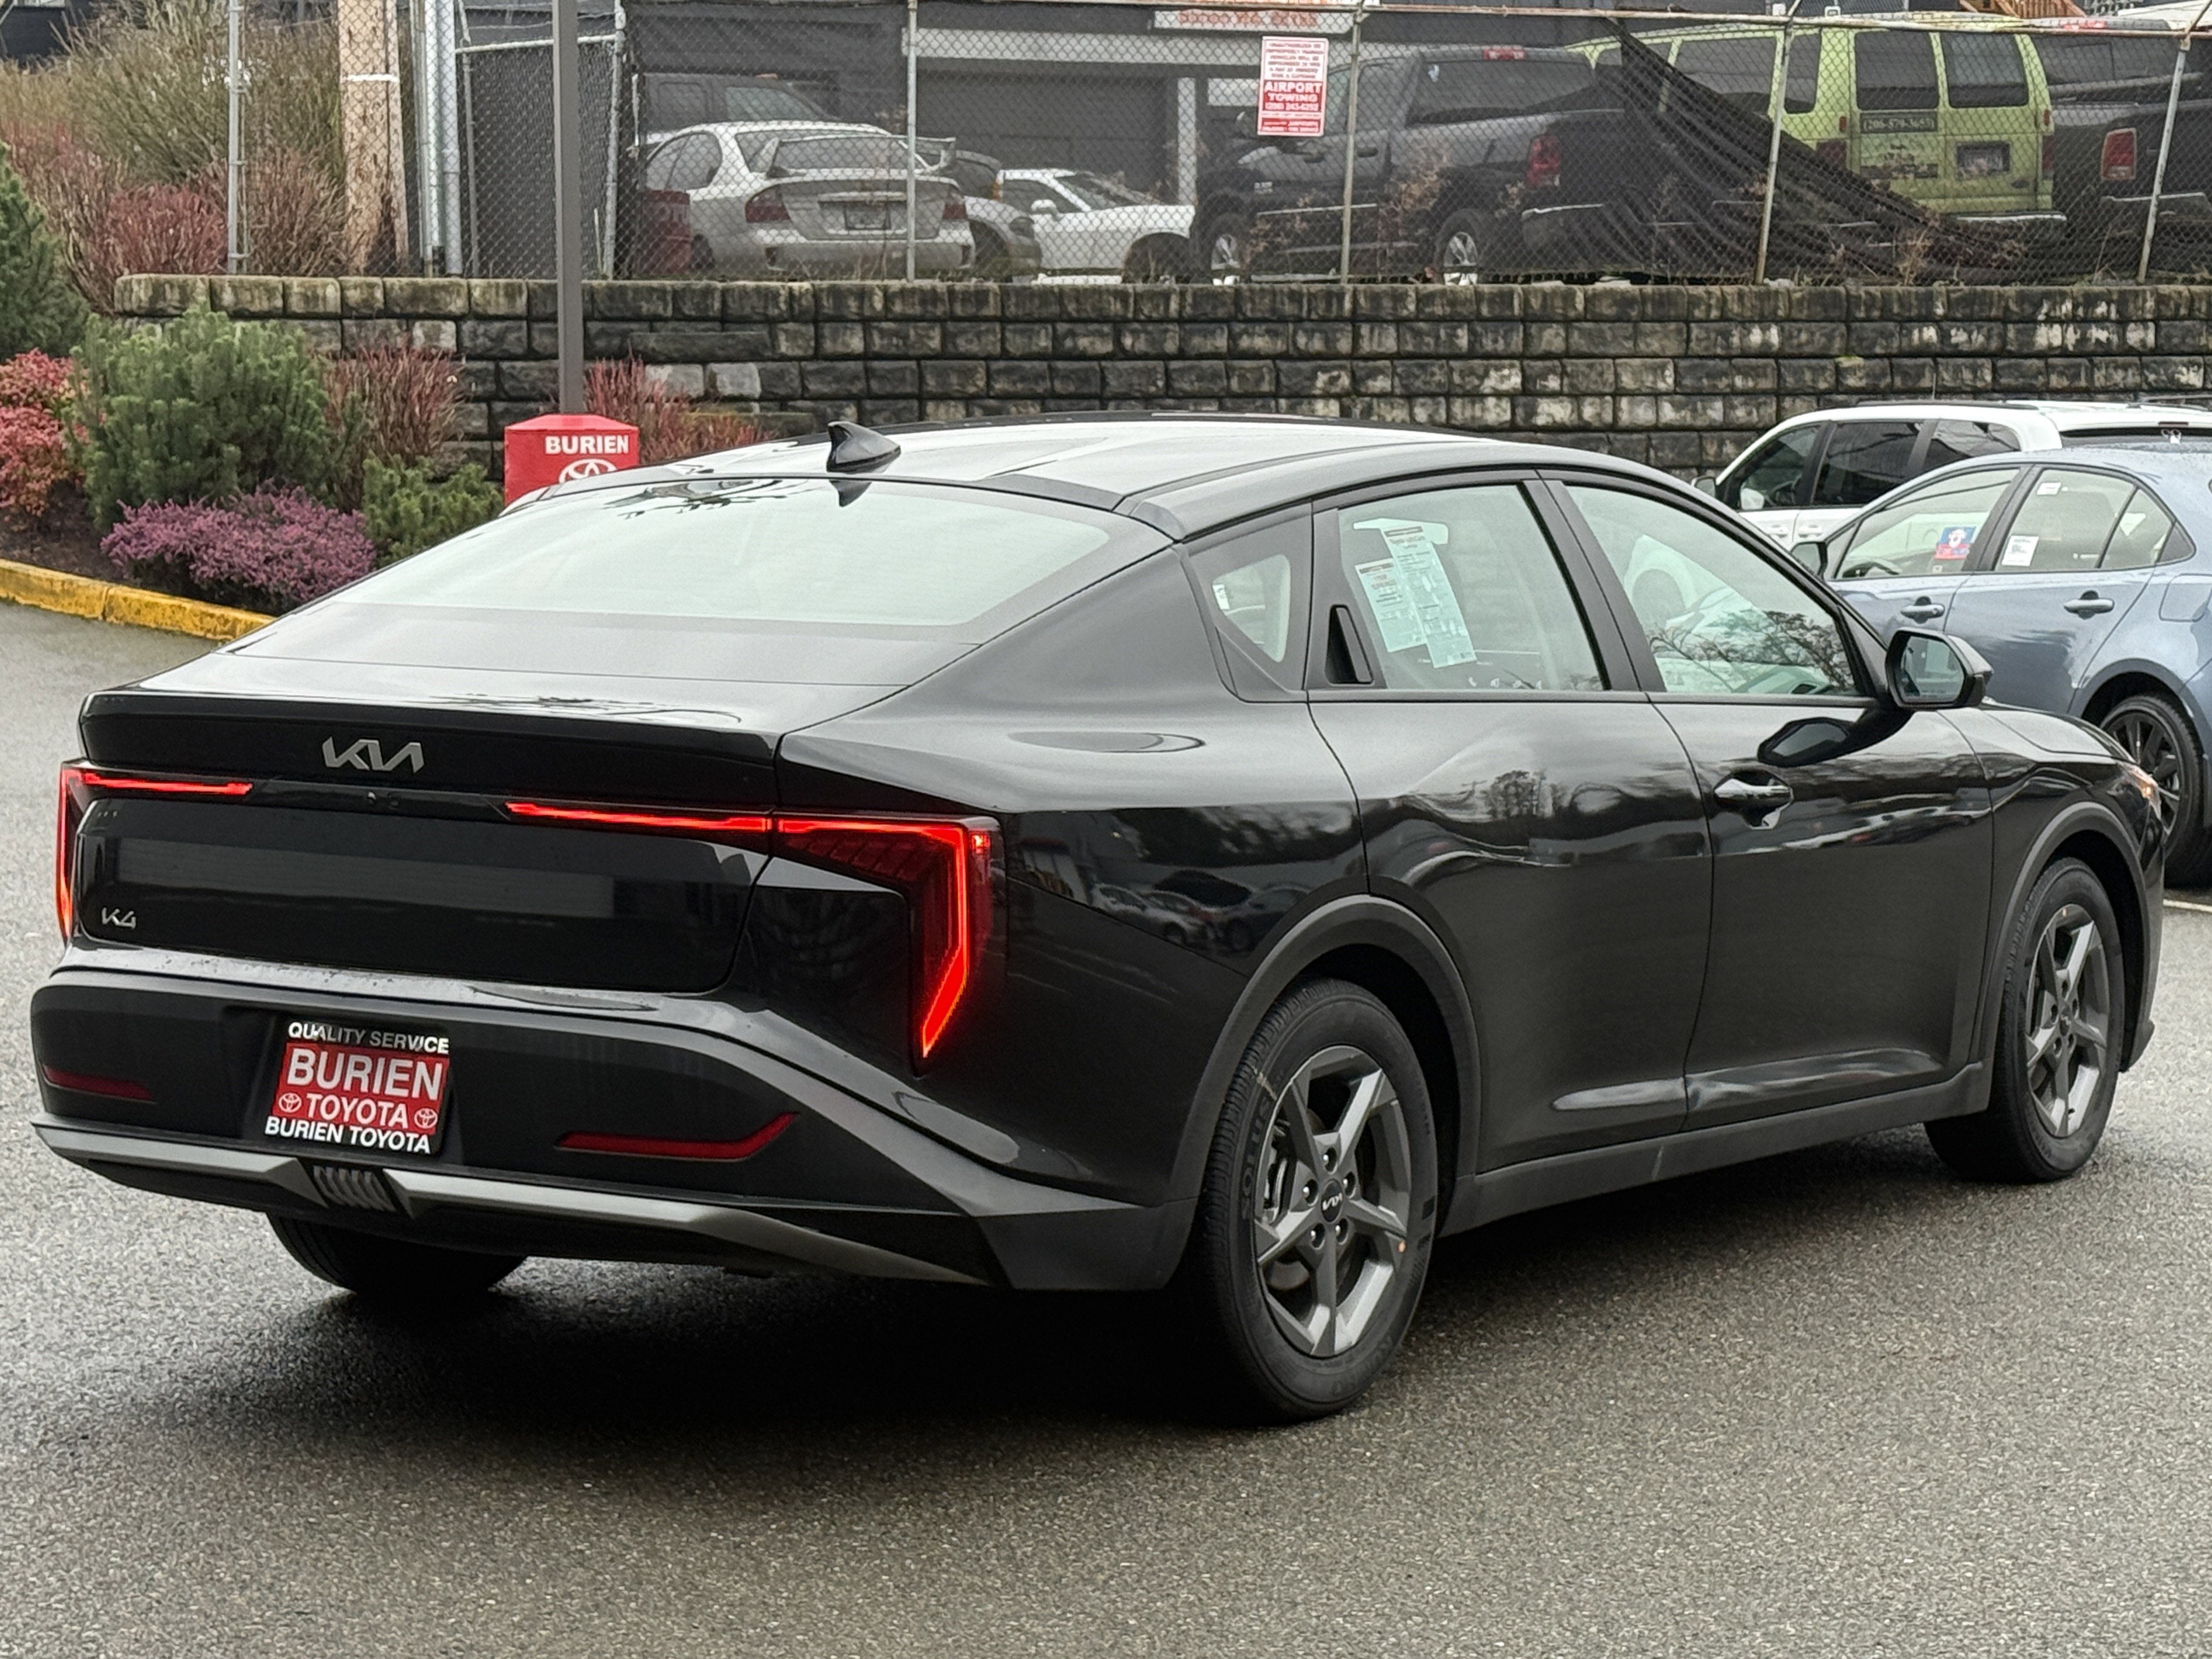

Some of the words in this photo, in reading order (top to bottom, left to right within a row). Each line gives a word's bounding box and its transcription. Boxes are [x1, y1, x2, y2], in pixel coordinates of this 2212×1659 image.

[1264, 81, 1322, 93] AIRPORT
[1267, 92, 1318, 103] TOWING
[545, 435, 630, 454] BURIEN
[322, 736, 425, 774] KIA
[101, 907, 137, 929] K4
[288, 1022, 366, 1045] QUALITY
[370, 1030, 449, 1054] SERVICE
[286, 1048, 443, 1101] BURIEN
[306, 1092, 409, 1130] TOYOTA
[264, 1115, 344, 1144] BURIEN
[349, 1125, 431, 1154] TOYOTA
